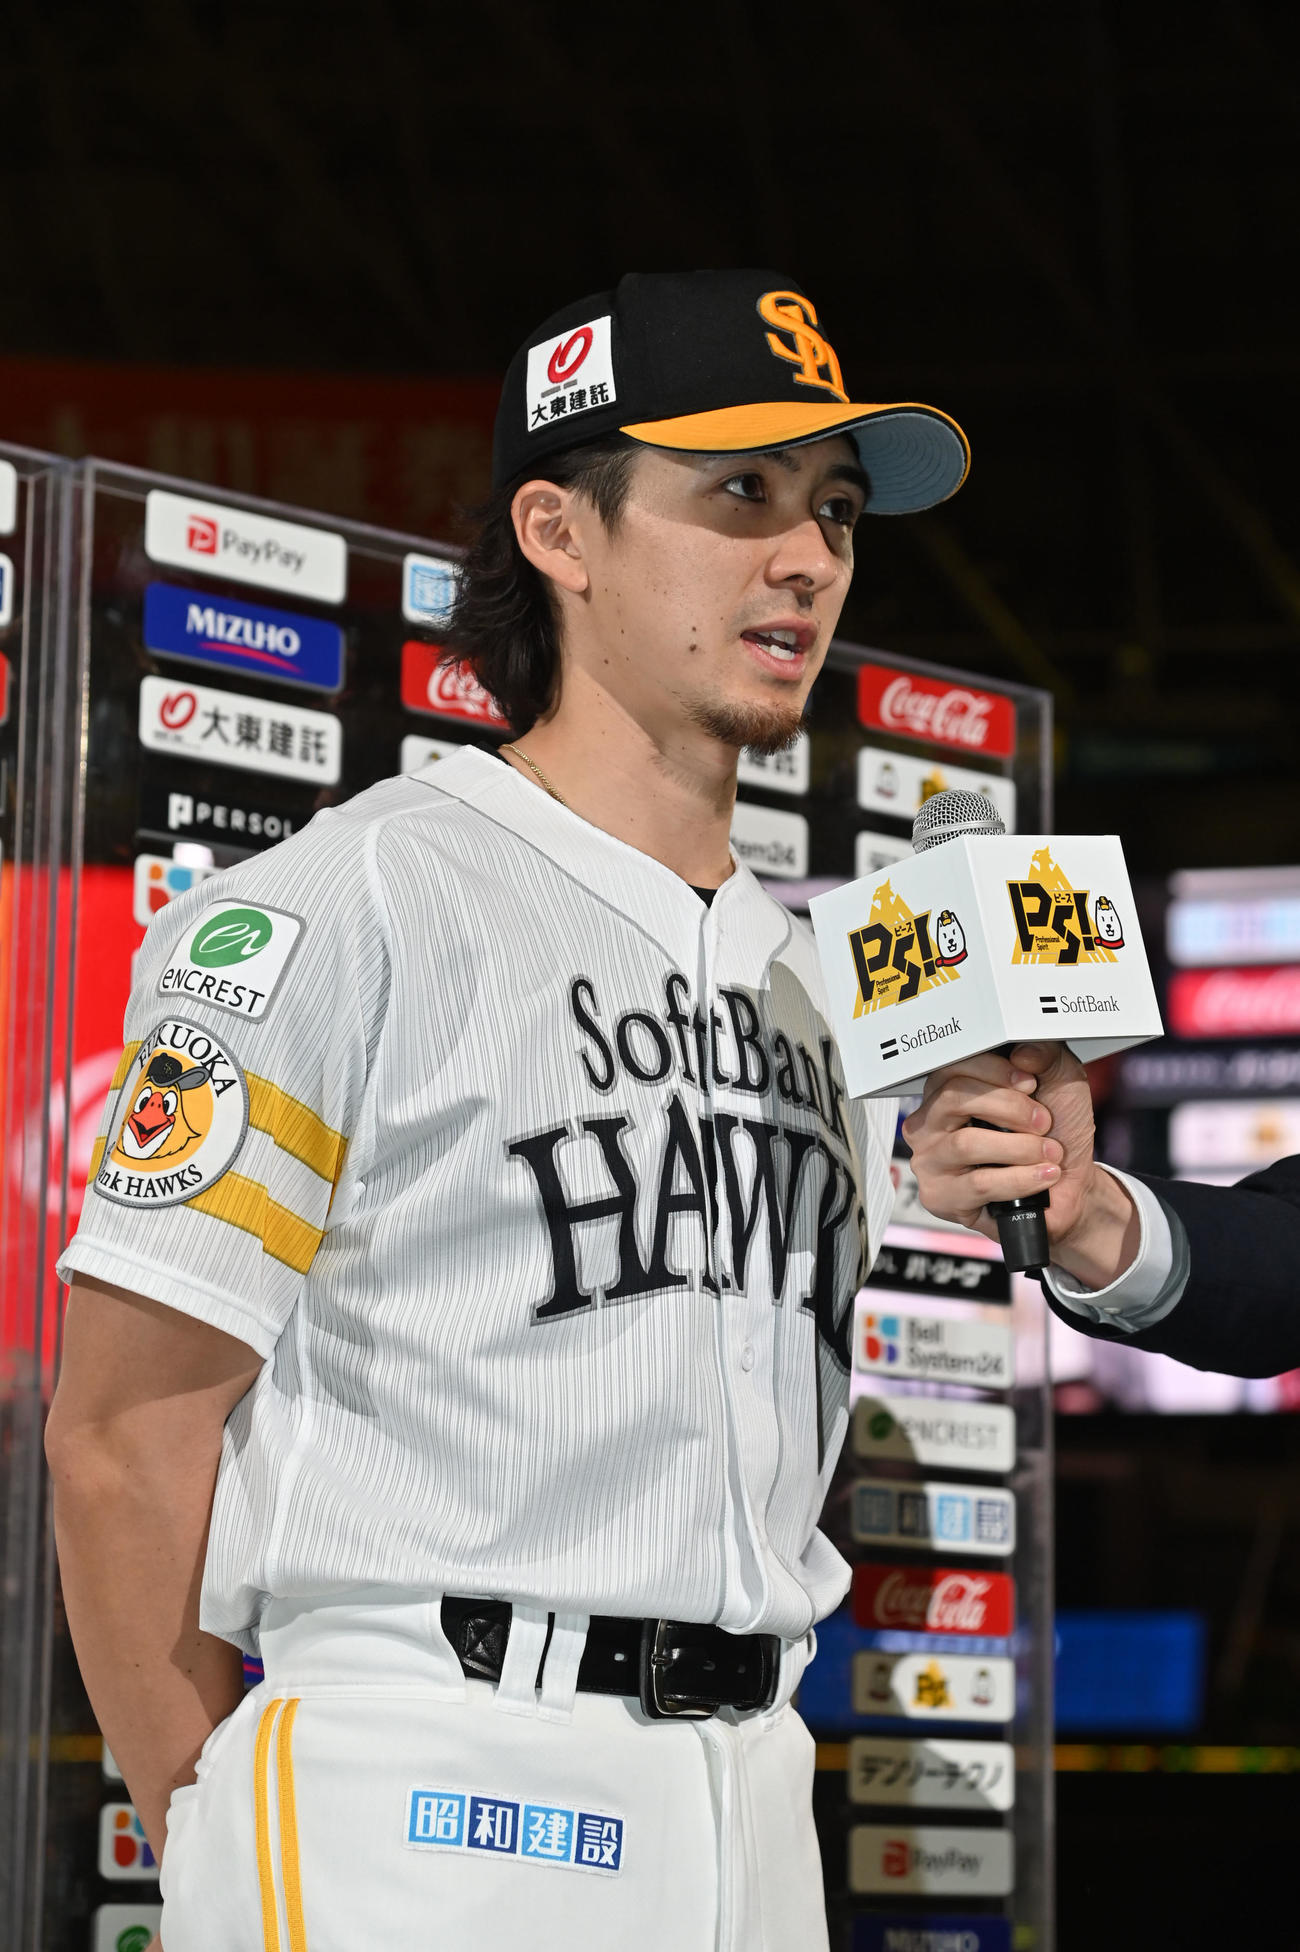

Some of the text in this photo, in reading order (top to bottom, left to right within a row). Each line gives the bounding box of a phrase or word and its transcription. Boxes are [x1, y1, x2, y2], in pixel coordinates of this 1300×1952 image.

[531, 383, 610, 427] 大東建託
[222, 529, 306, 573] PayPay
[186, 603, 300, 657] MIZUHO
[201, 706, 327, 765] 大東建託
[196, 801, 293, 839] PERSOL
[1053, 893, 1073, 904] ピース
[894, 921, 914, 937] ピース
[875, 971, 901, 987] Professional
[877, 984, 890, 996] Spirit
[1060, 995, 1120, 1013] SoftBank
[900, 1016, 963, 1053] SoftBank
[570, 972, 853, 1140] SoftBank
[124, 1163, 203, 1198] HAWKS
[506, 1092, 868, 1372] HAWK
[414, 1797, 619, 1868] 昭和建設
